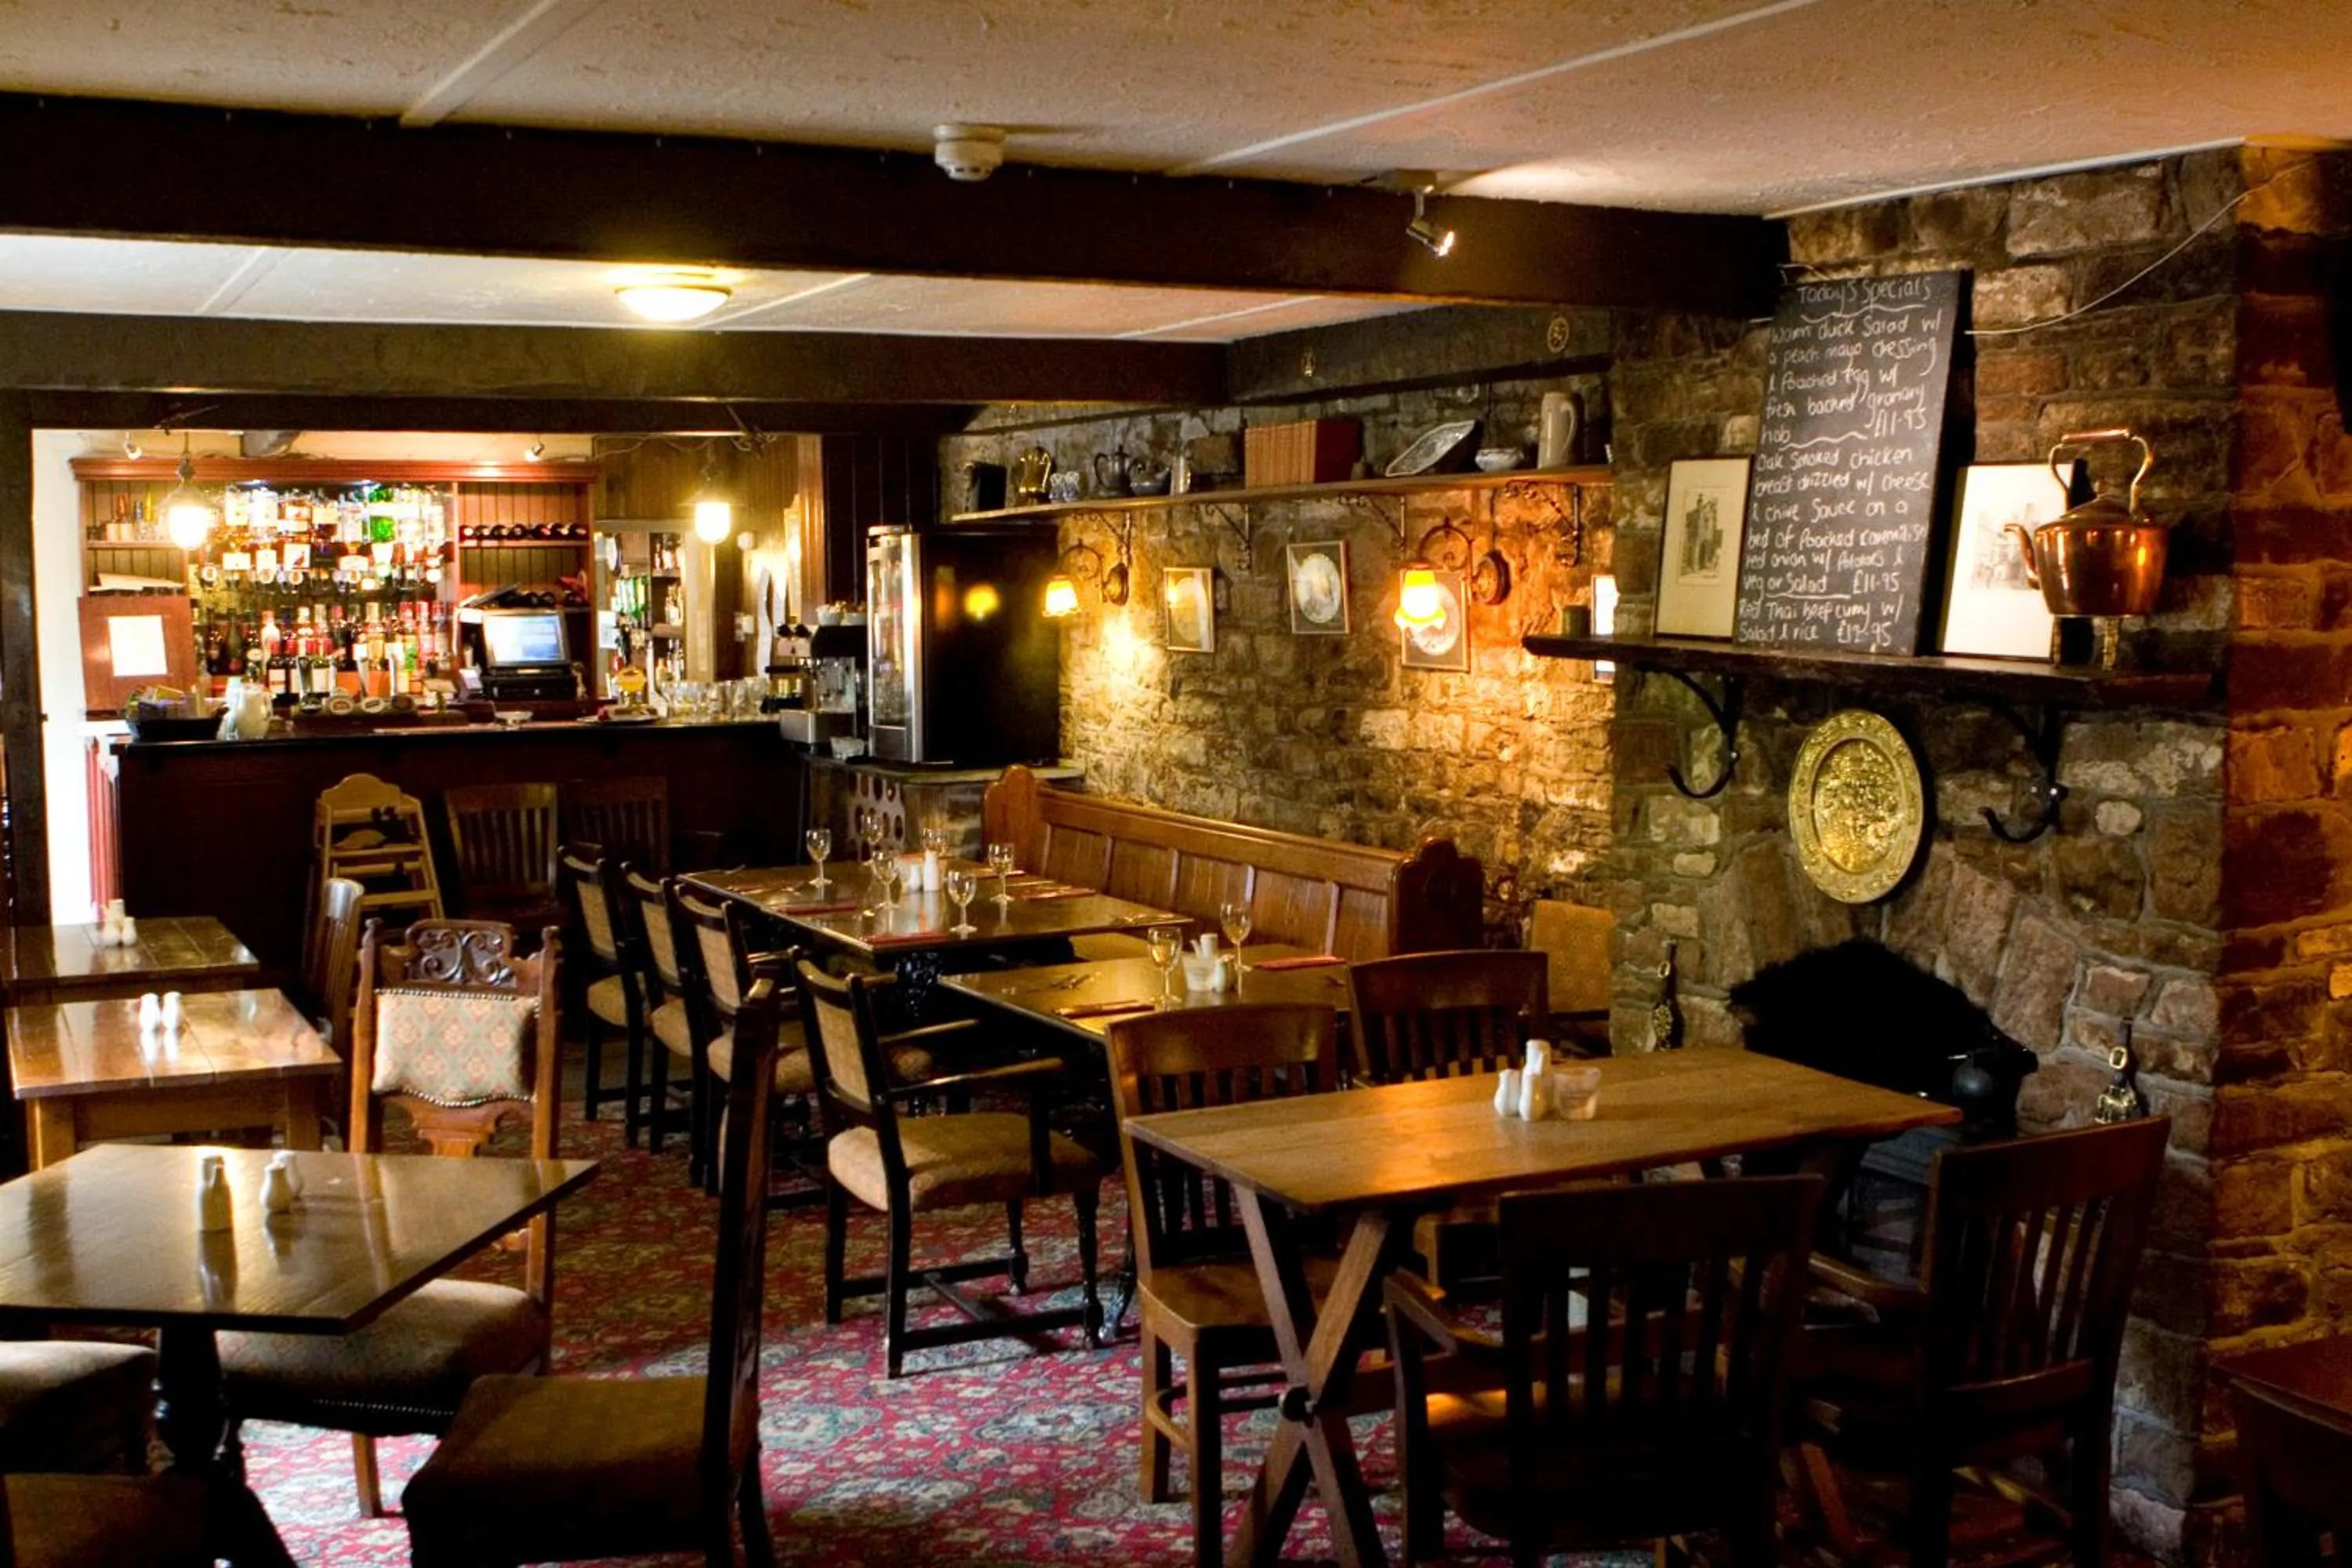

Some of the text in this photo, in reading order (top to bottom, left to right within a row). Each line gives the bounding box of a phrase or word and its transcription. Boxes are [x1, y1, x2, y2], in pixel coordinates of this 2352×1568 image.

[1865, 501, 1886, 517] on
[1895, 499, 1909, 514] a
[1766, 578, 1784, 590] or
[1766, 601, 1798, 622] Thai
